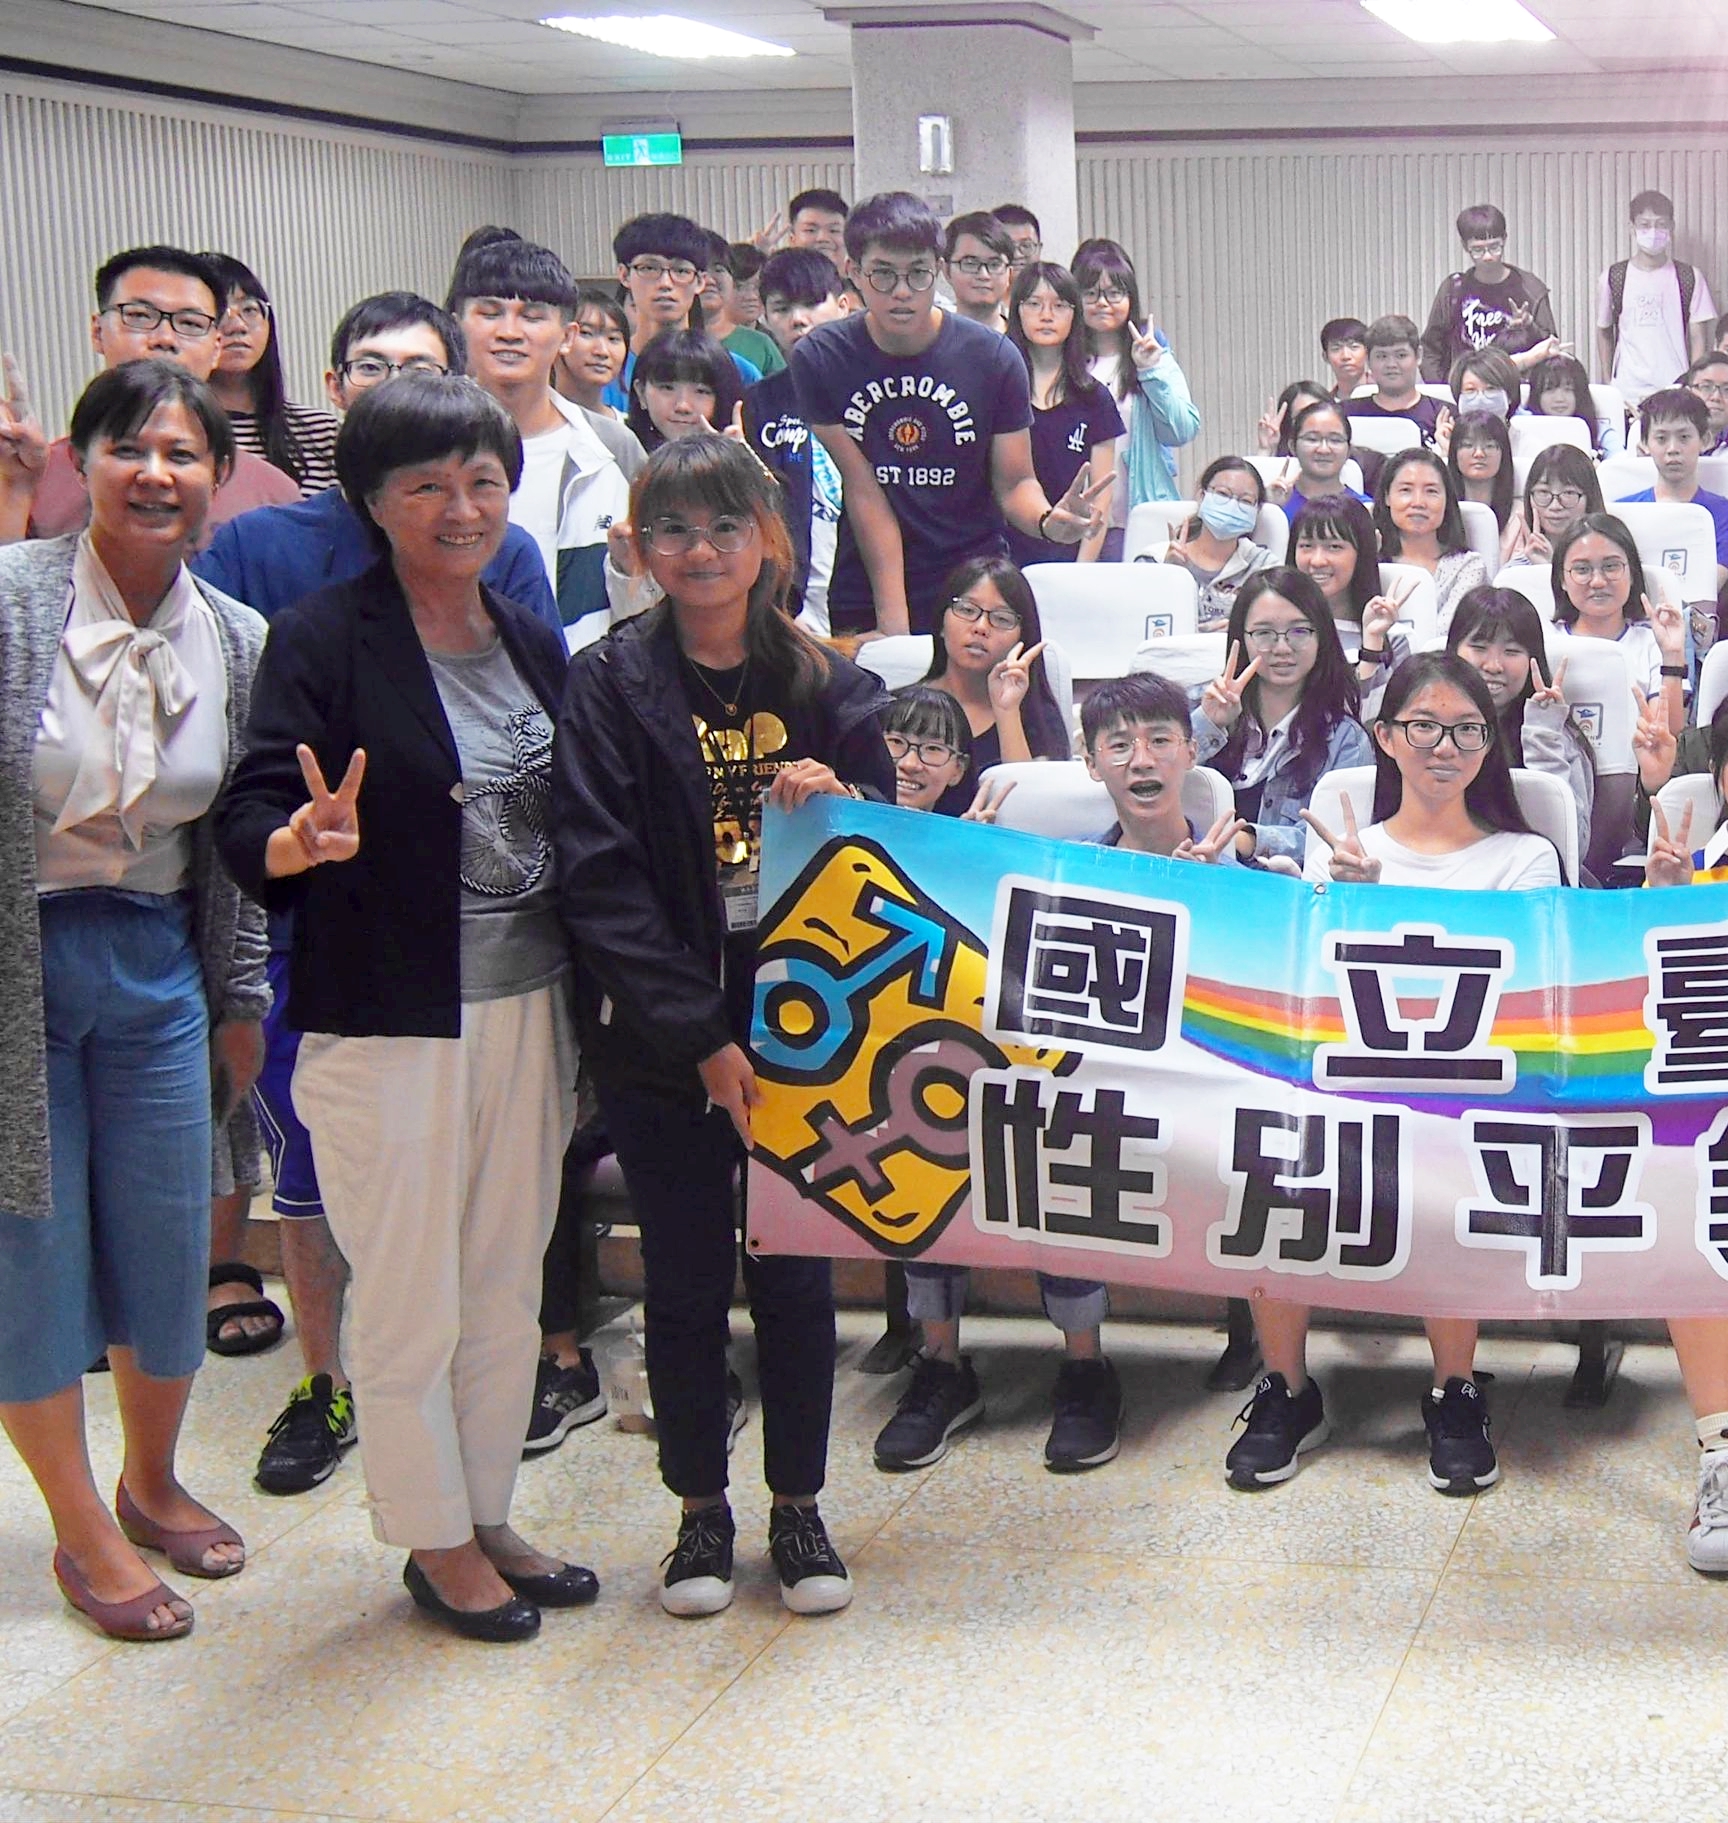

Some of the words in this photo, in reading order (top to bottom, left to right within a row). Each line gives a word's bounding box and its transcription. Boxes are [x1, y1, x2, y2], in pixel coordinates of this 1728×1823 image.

[1461, 299, 1503, 337] Free
[844, 375, 976, 446] ABERCROMBIE
[876, 466, 901, 485] ST
[907, 467, 956, 486] 1892
